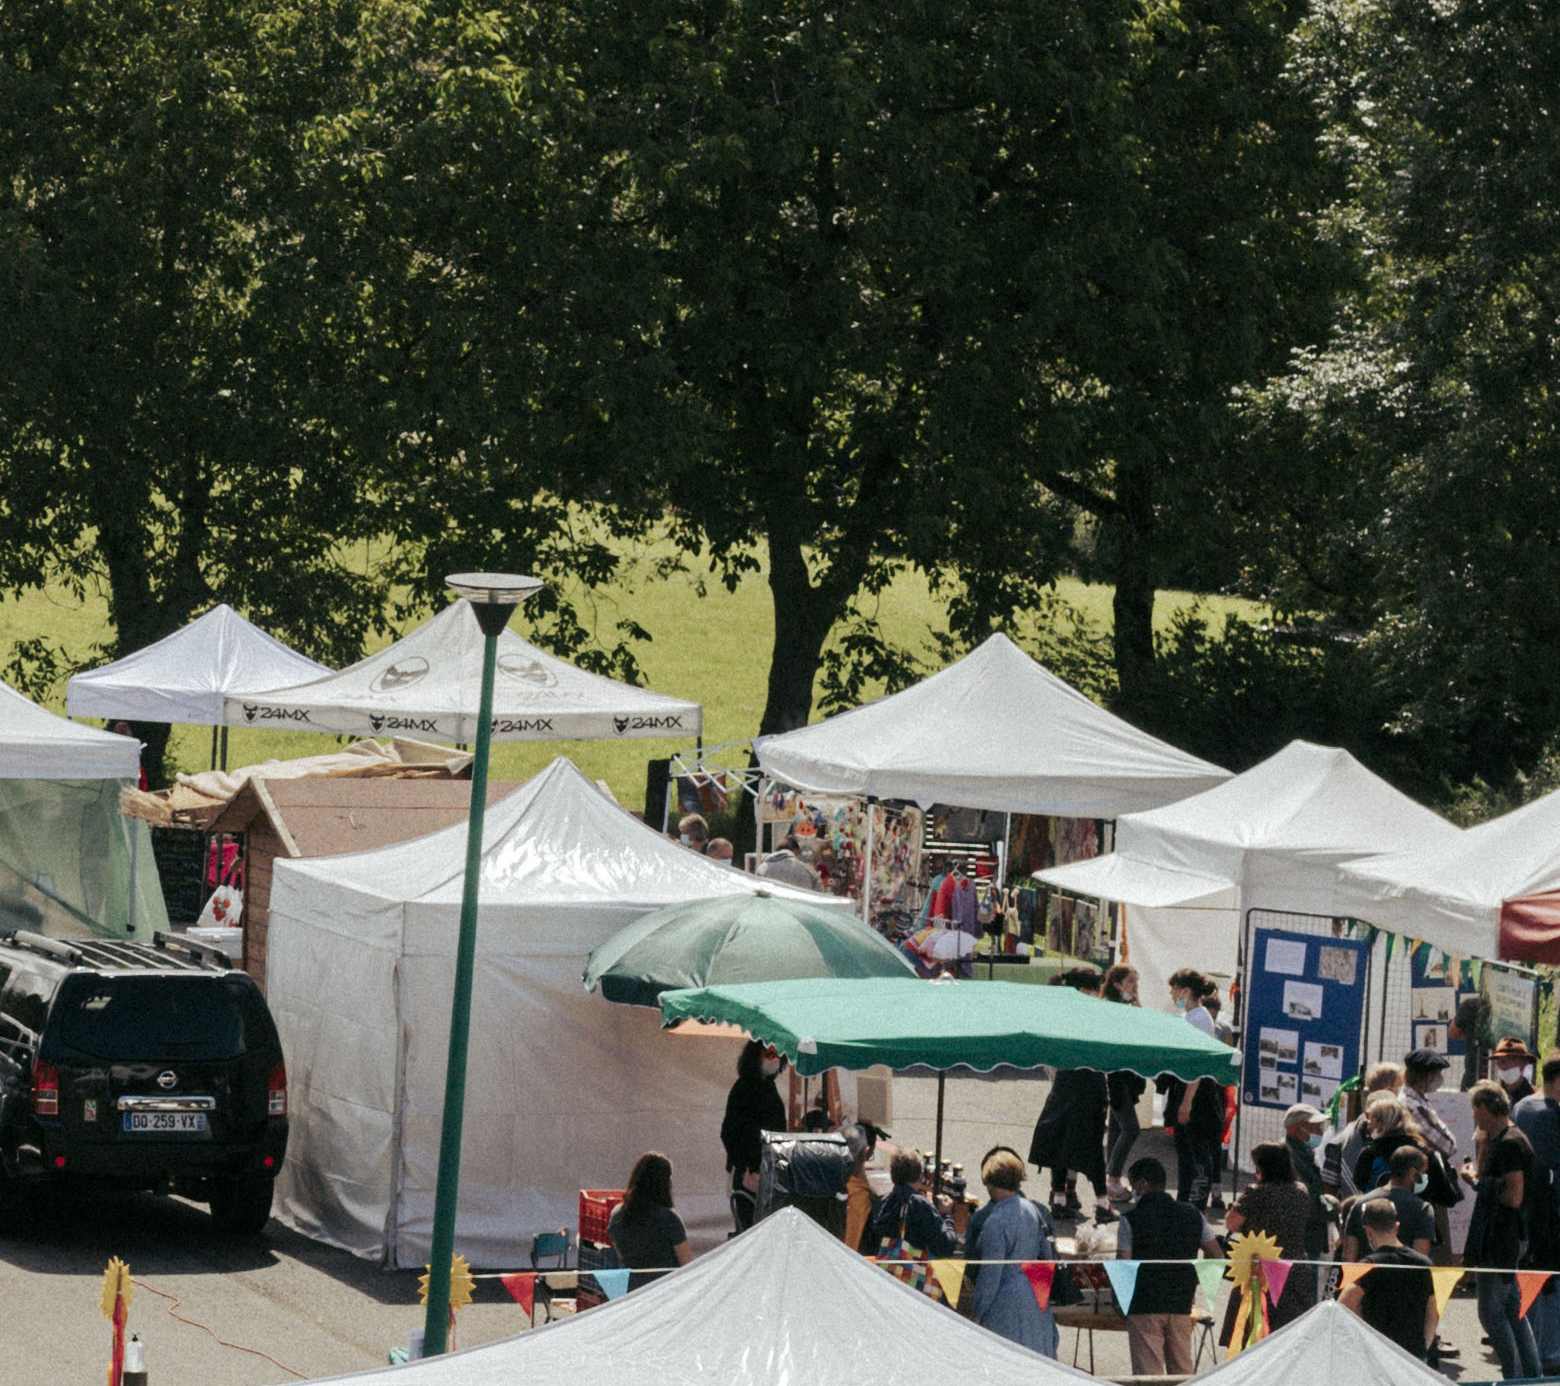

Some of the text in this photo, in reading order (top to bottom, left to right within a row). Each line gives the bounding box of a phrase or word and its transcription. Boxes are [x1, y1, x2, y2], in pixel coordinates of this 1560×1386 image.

[260, 706, 311, 722] 24MX
[386, 716, 438, 732] 24MX
[499, 718, 553, 732] 24MX
[631, 715, 683, 730] 24MX
